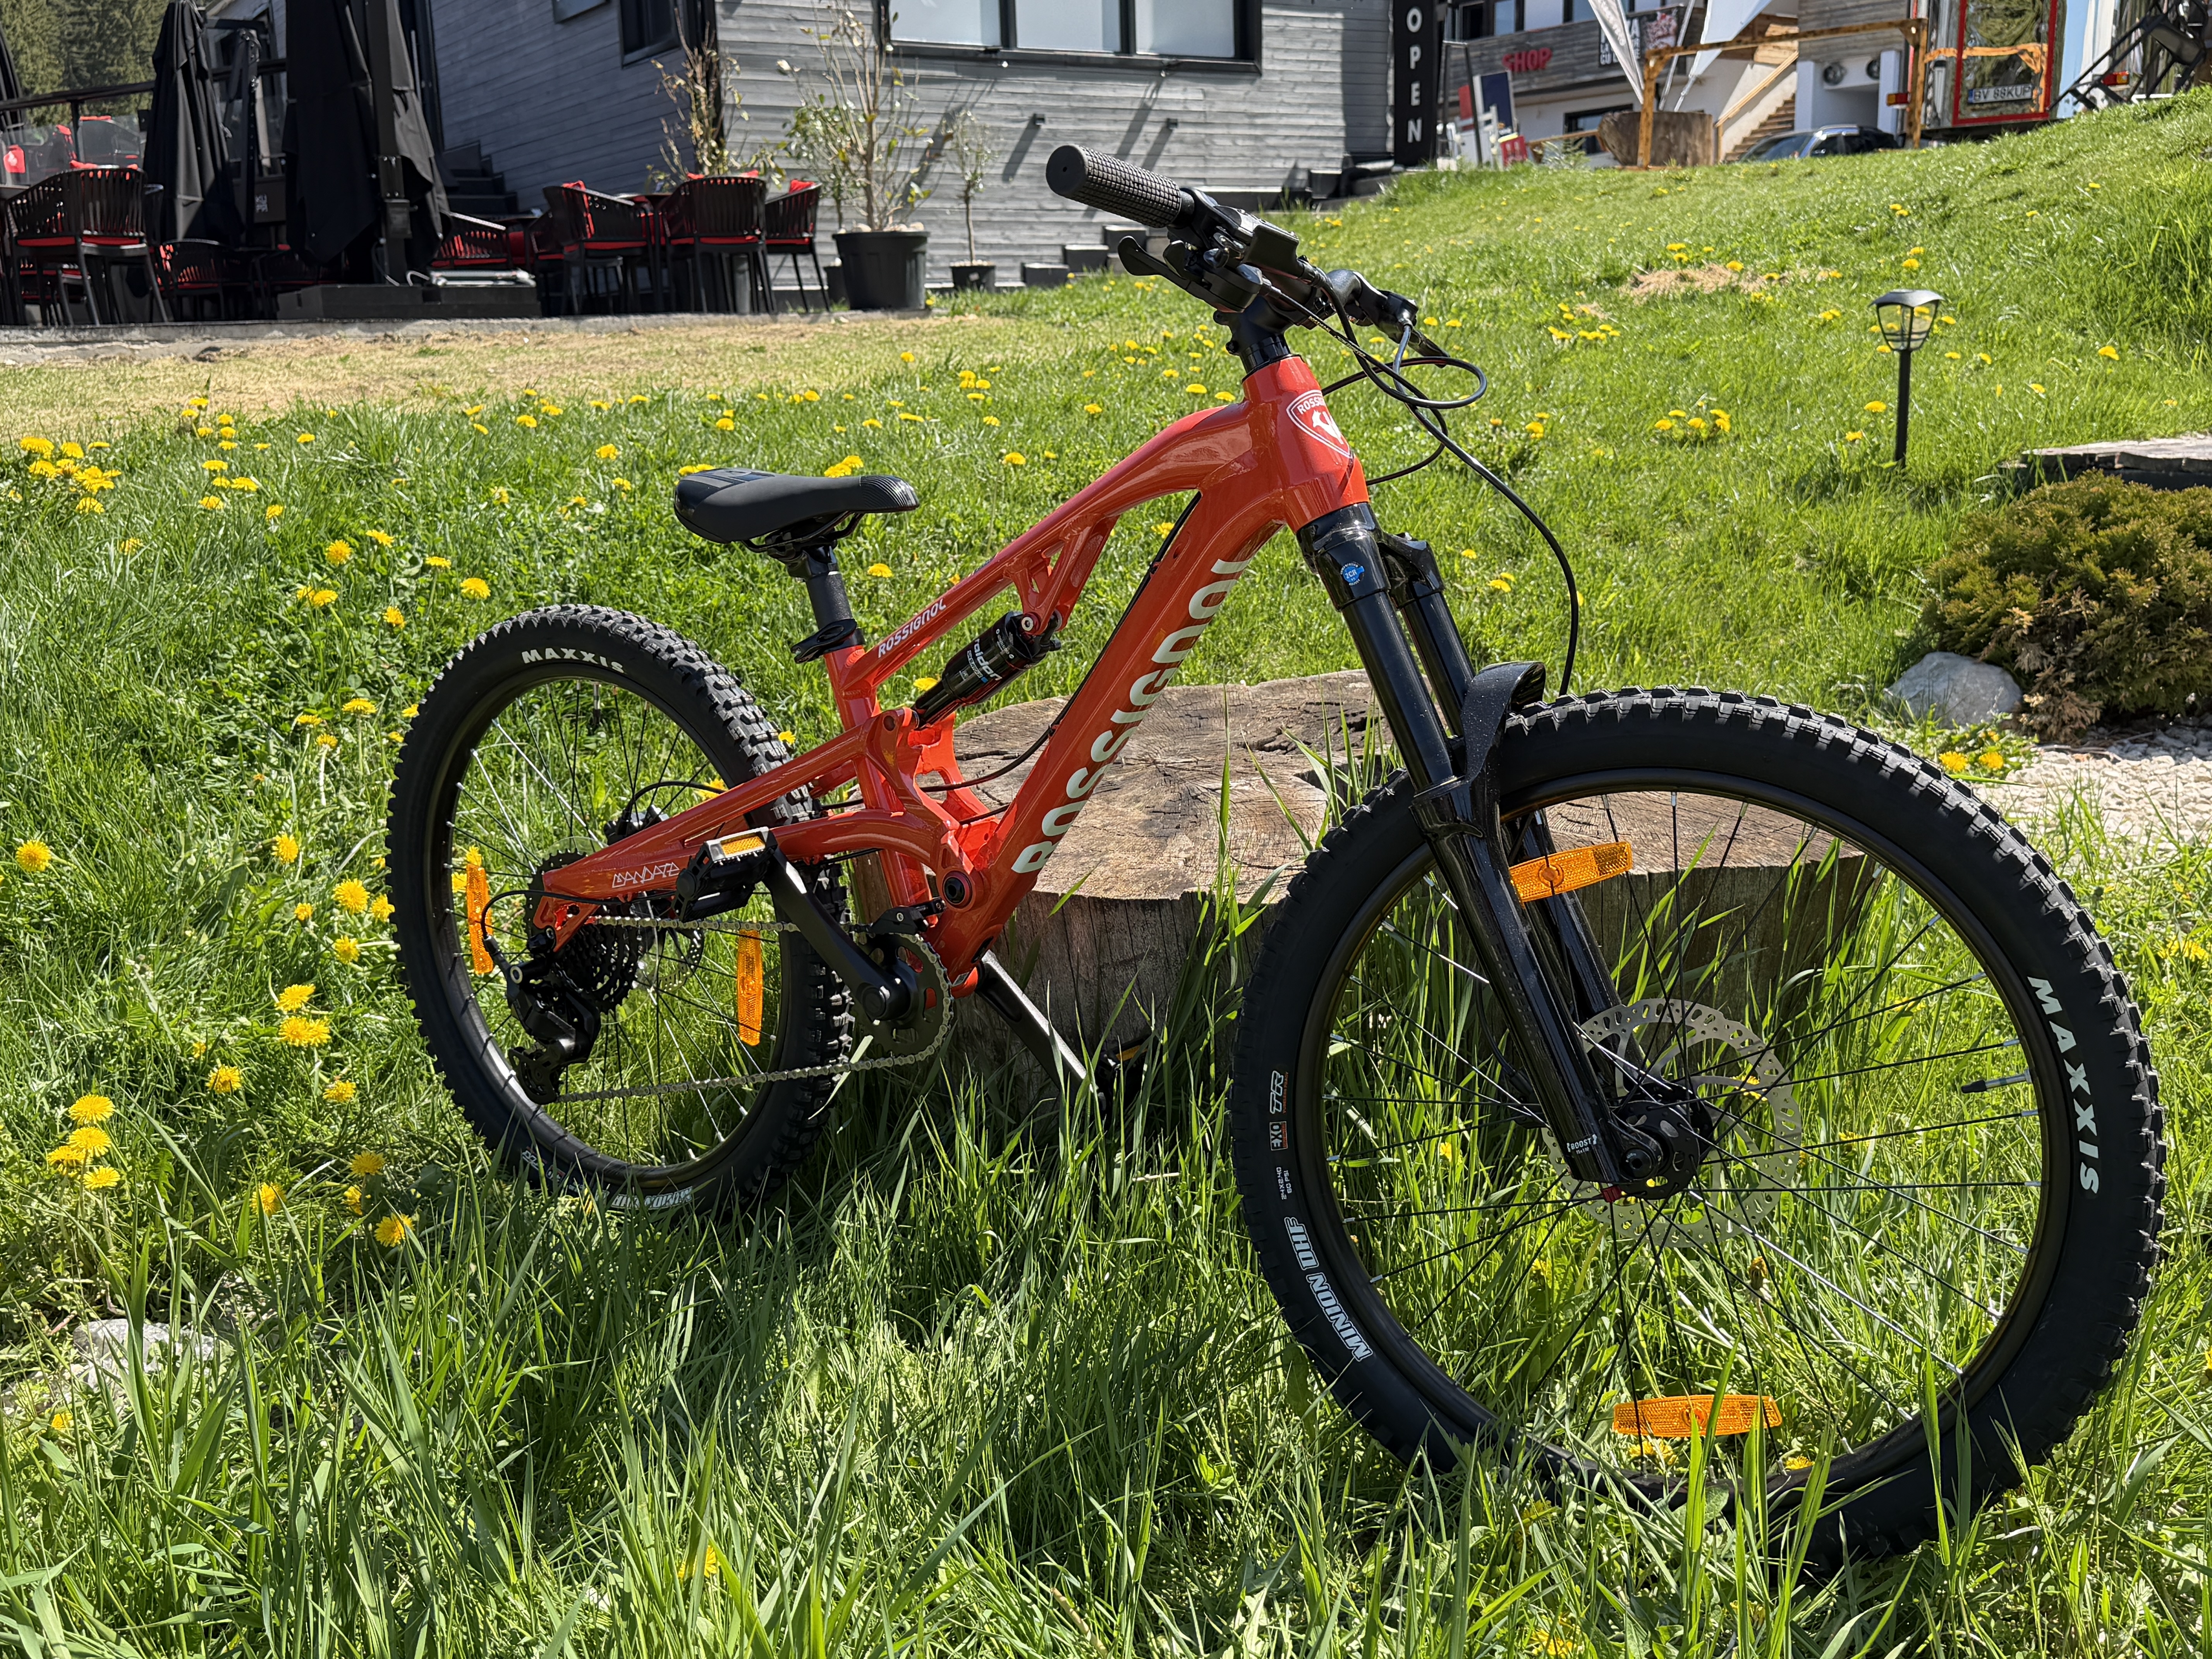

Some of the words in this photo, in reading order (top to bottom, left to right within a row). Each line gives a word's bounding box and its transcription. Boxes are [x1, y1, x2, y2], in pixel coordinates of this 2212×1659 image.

[1406, 6, 1423, 143] OPEN
[1501, 47, 1553, 72] SHOP
[1974, 89, 1989, 101] BV
[878, 598, 946, 658] ROSSIGNOL
[522, 647, 626, 673] MAXXIS
[1269, 1070, 1285, 1115] TR
[2027, 976, 2099, 1194] MAXXIS
[1270, 1122, 1282, 1150] EXO
[1570, 1137, 1592, 1150] BOOST
[1284, 1216, 1319, 1271] DHF
[1306, 1273, 1373, 1362] MINION
